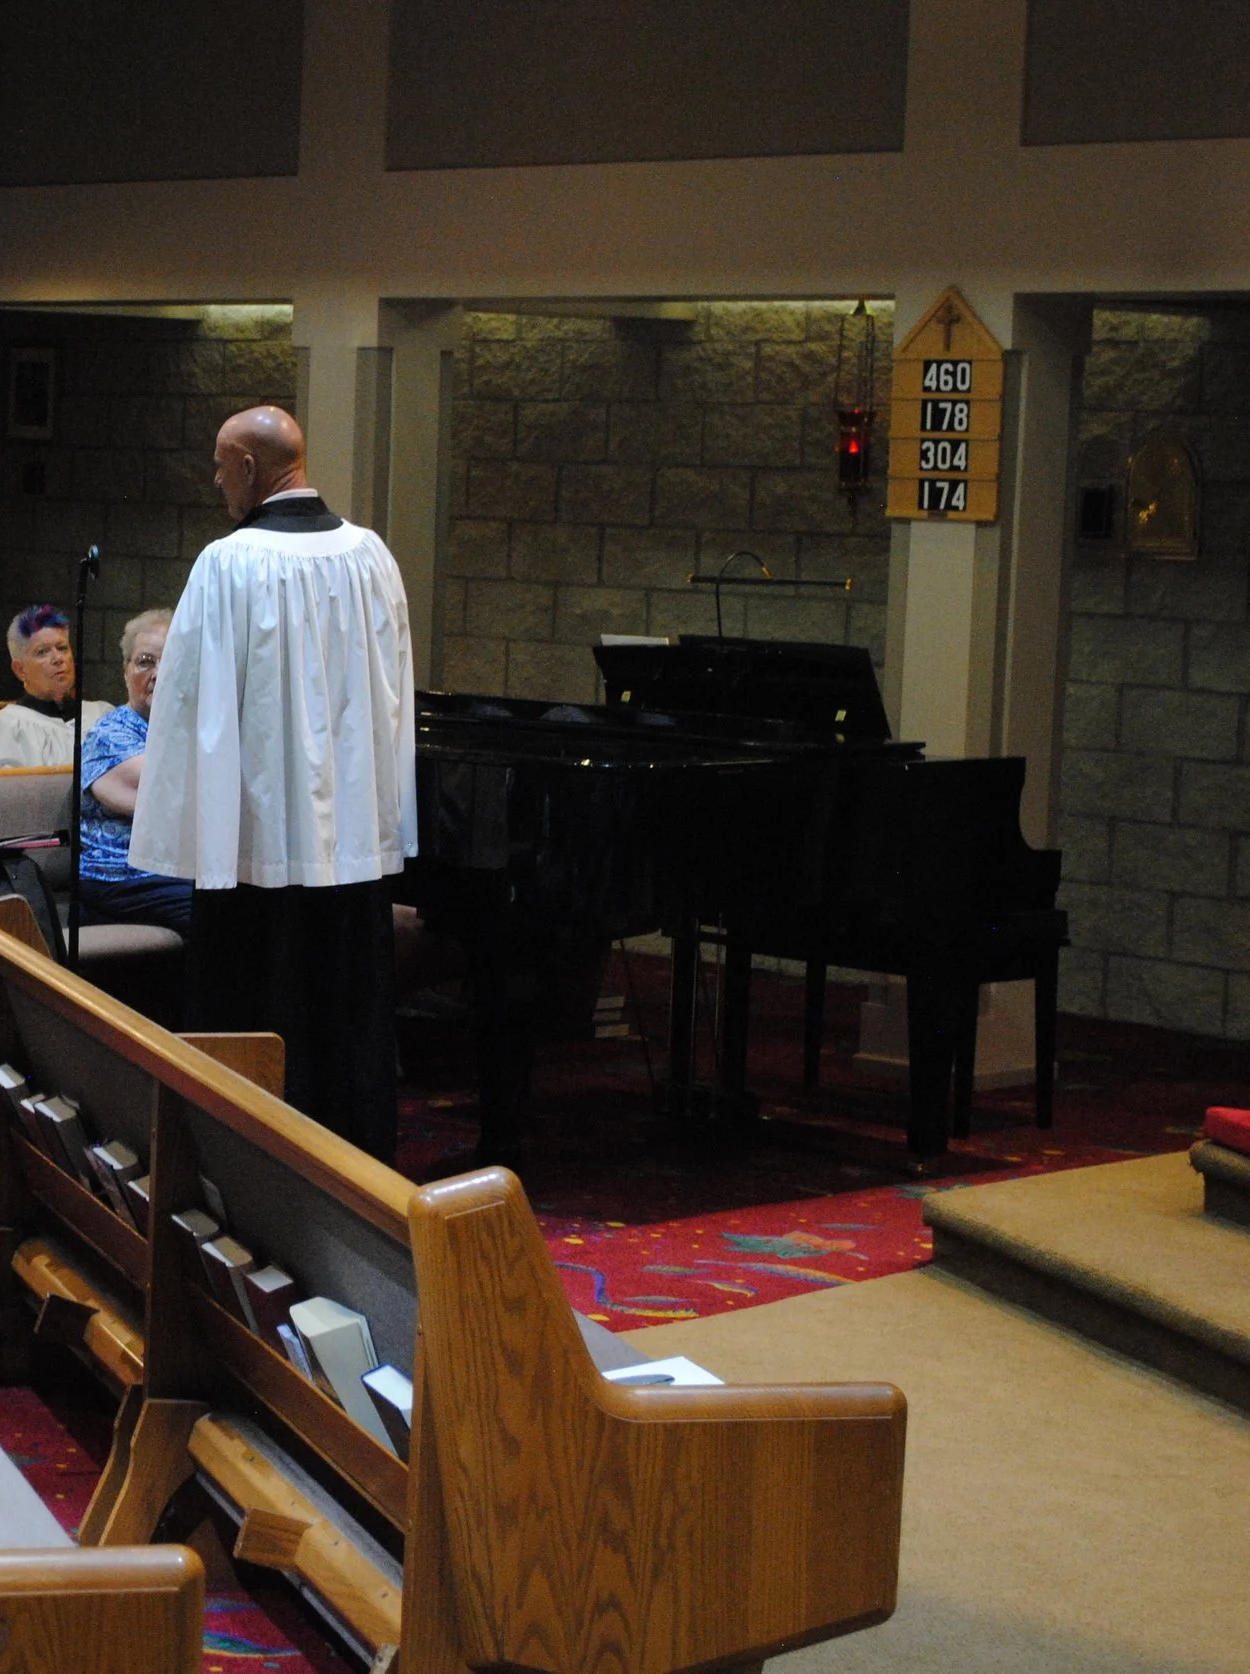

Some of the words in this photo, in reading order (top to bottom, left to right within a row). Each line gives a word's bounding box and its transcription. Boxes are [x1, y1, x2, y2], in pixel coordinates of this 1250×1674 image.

[924, 362, 971, 392] 460
[925, 402, 968, 431] 178
[921, 441, 967, 470] 304
[923, 481, 966, 511] 174
